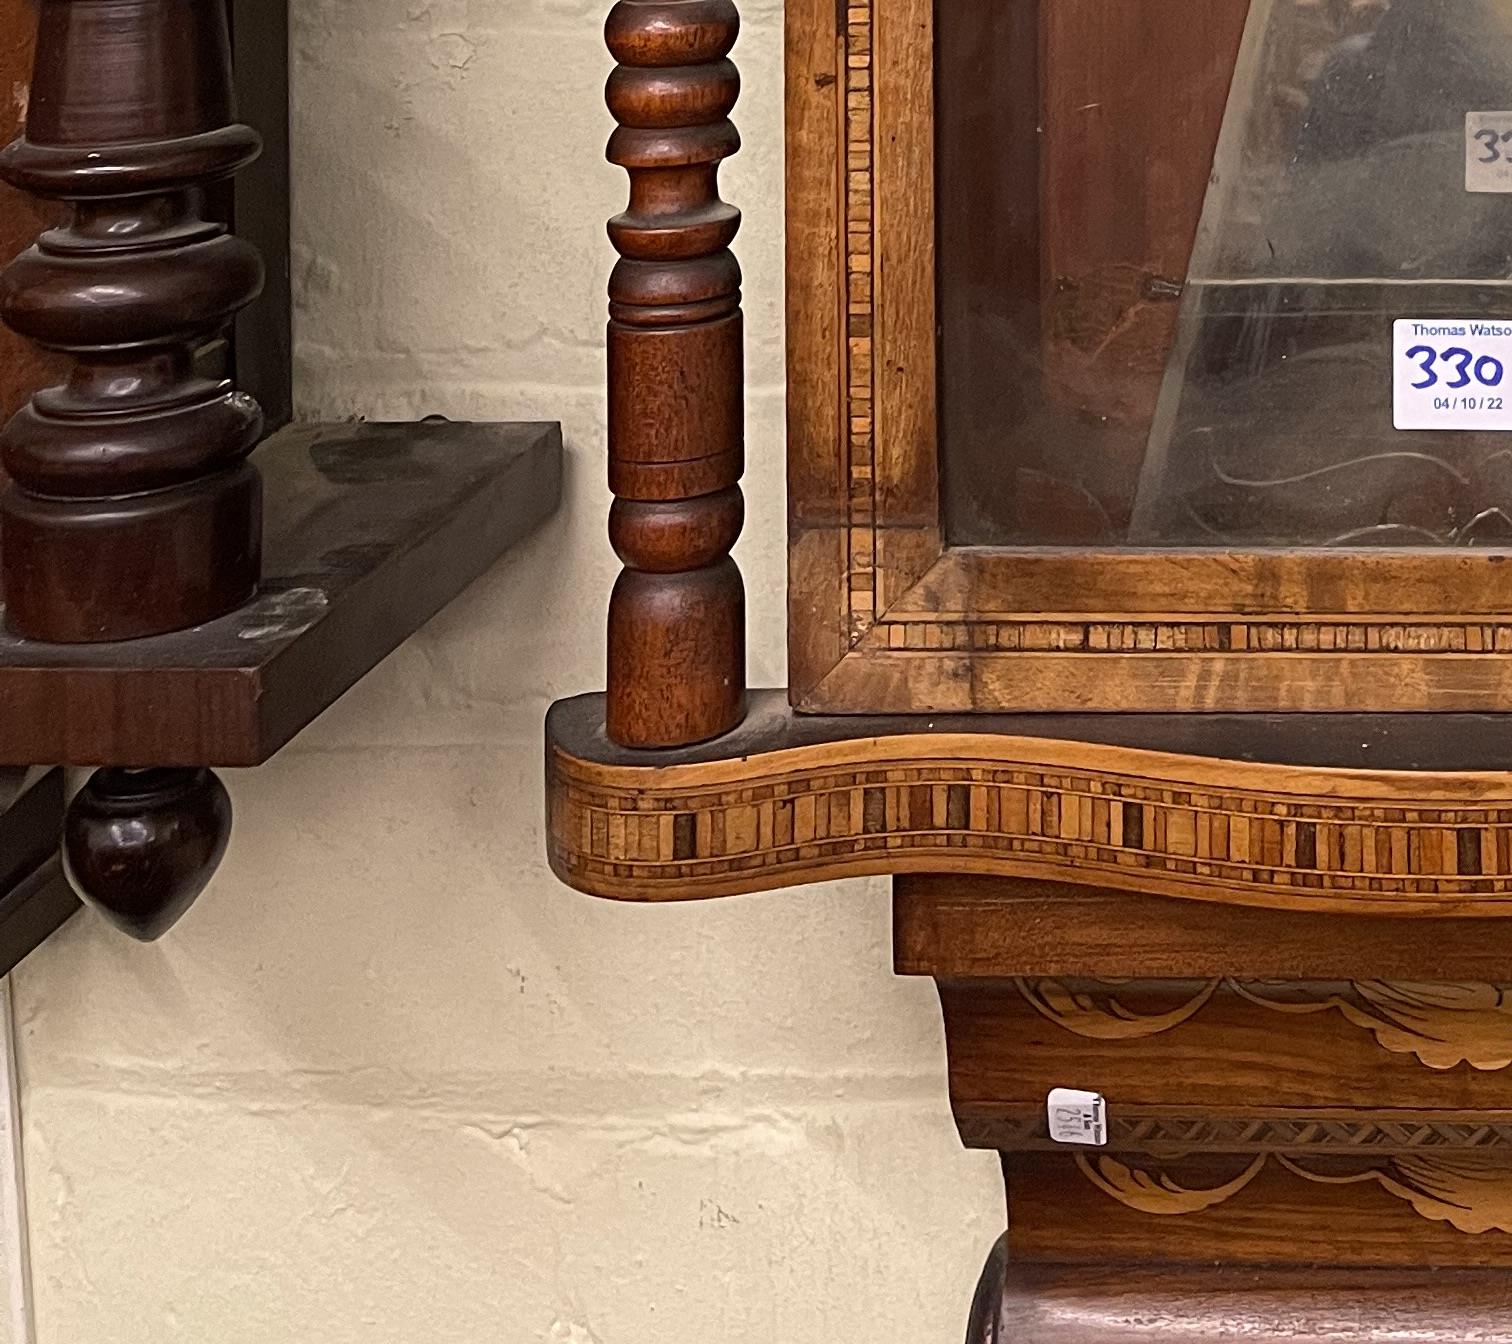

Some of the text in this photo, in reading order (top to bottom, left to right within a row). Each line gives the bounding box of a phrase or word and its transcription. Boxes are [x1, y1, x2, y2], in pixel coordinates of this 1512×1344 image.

[1411, 323, 1467, 337] Thomas
[1405, 344, 1504, 390] 330
[1433, 397, 1450, 410] 04
[1460, 397, 1477, 410] 10
[1487, 398, 1503, 410] 22
